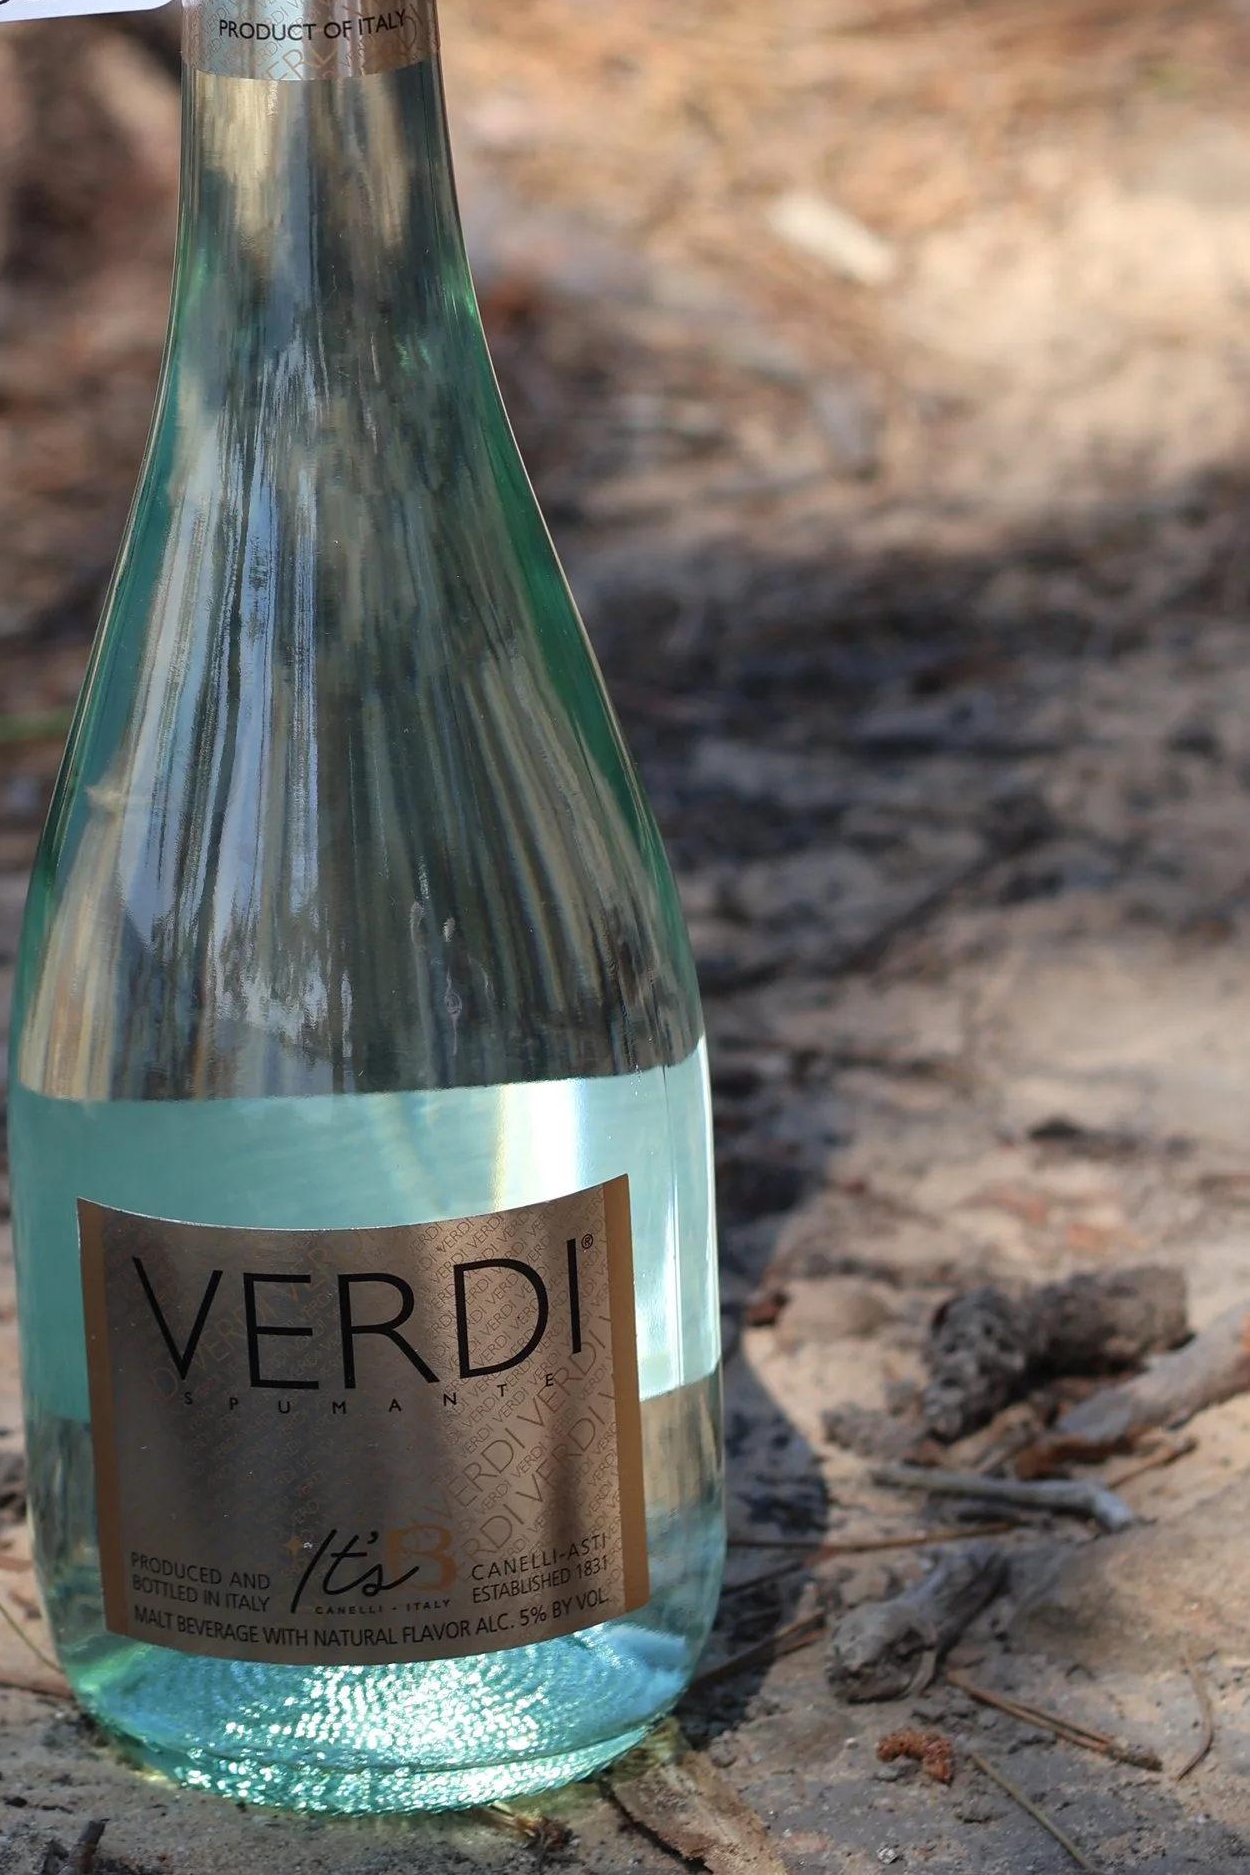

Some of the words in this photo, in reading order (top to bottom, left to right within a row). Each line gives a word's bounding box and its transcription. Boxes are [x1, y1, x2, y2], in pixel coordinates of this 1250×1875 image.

[219, 19, 317, 41] PRODUCT
[323, 20, 353, 40] OF
[358, 9, 408, 36] ITALY
[184, 1373, 555, 1414] SPUMANTE
[131, 1551, 222, 1585] PRODUCED
[229, 1571, 271, 1590] AND
[471, 1533, 607, 1581] CANELLI-ASTI
[132, 1574, 198, 1603] BOTTLED
[203, 1589, 220, 1607] IN
[225, 1593, 271, 1612] ITALY
[472, 1567, 571, 1604] ESTABLISHED
[576, 1556, 609, 1579] 1831
[133, 1604, 175, 1626] MALT
[177, 1615, 260, 1643] BEVERAGE
[262, 1627, 308, 1647] WITH
[314, 1626, 398, 1647] NATURAL
[402, 1620, 471, 1643] FLAVOR
[475, 1613, 514, 1636] ALC.
[520, 1605, 547, 1626] 5%
[553, 1597, 573, 1619] BY
[315, 1605, 383, 1615] CANELLI
[406, 1599, 451, 1613] ITALY
